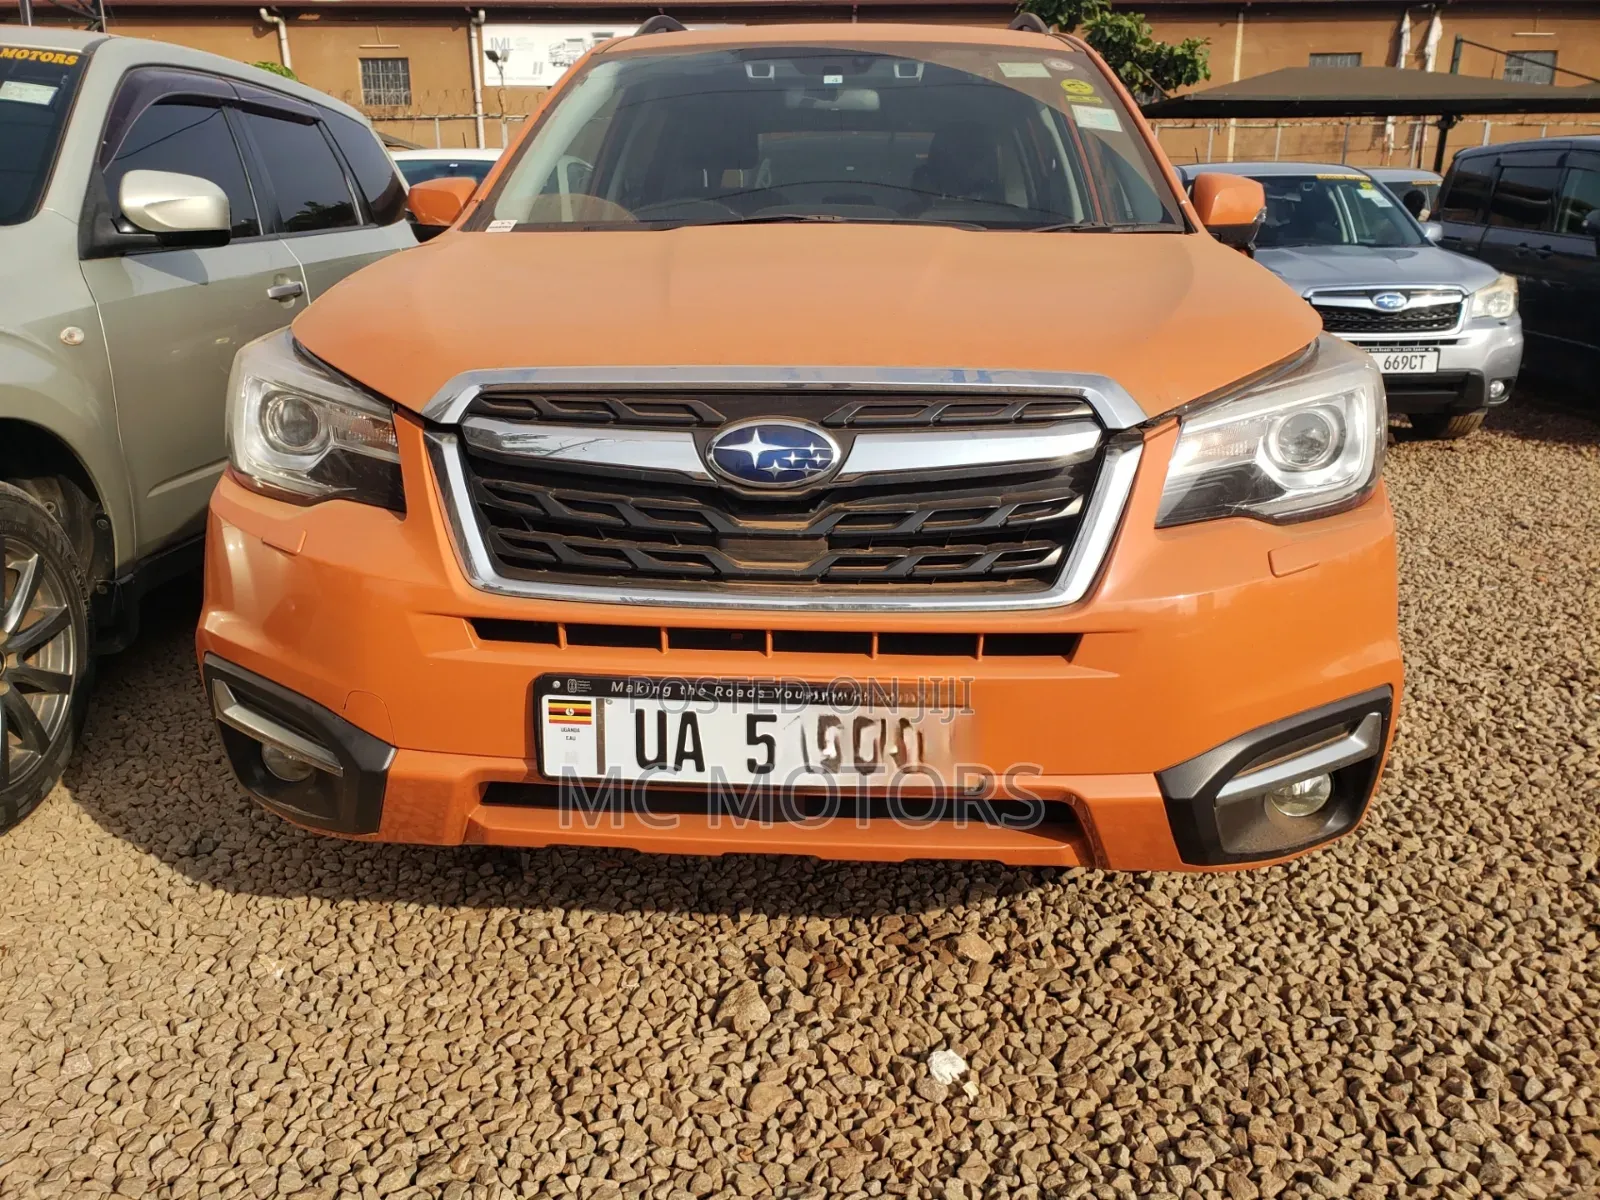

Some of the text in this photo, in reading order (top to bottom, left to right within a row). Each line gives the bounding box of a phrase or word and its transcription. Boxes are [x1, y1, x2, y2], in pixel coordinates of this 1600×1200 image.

[0, 47, 79, 65] MOTORS
[1383, 354, 1427, 371] 669CT
[611, 681, 672, 697] Making
[680, 684, 707, 697] the
[714, 686, 766, 699] Roads
[635, 707, 706, 773] UA
